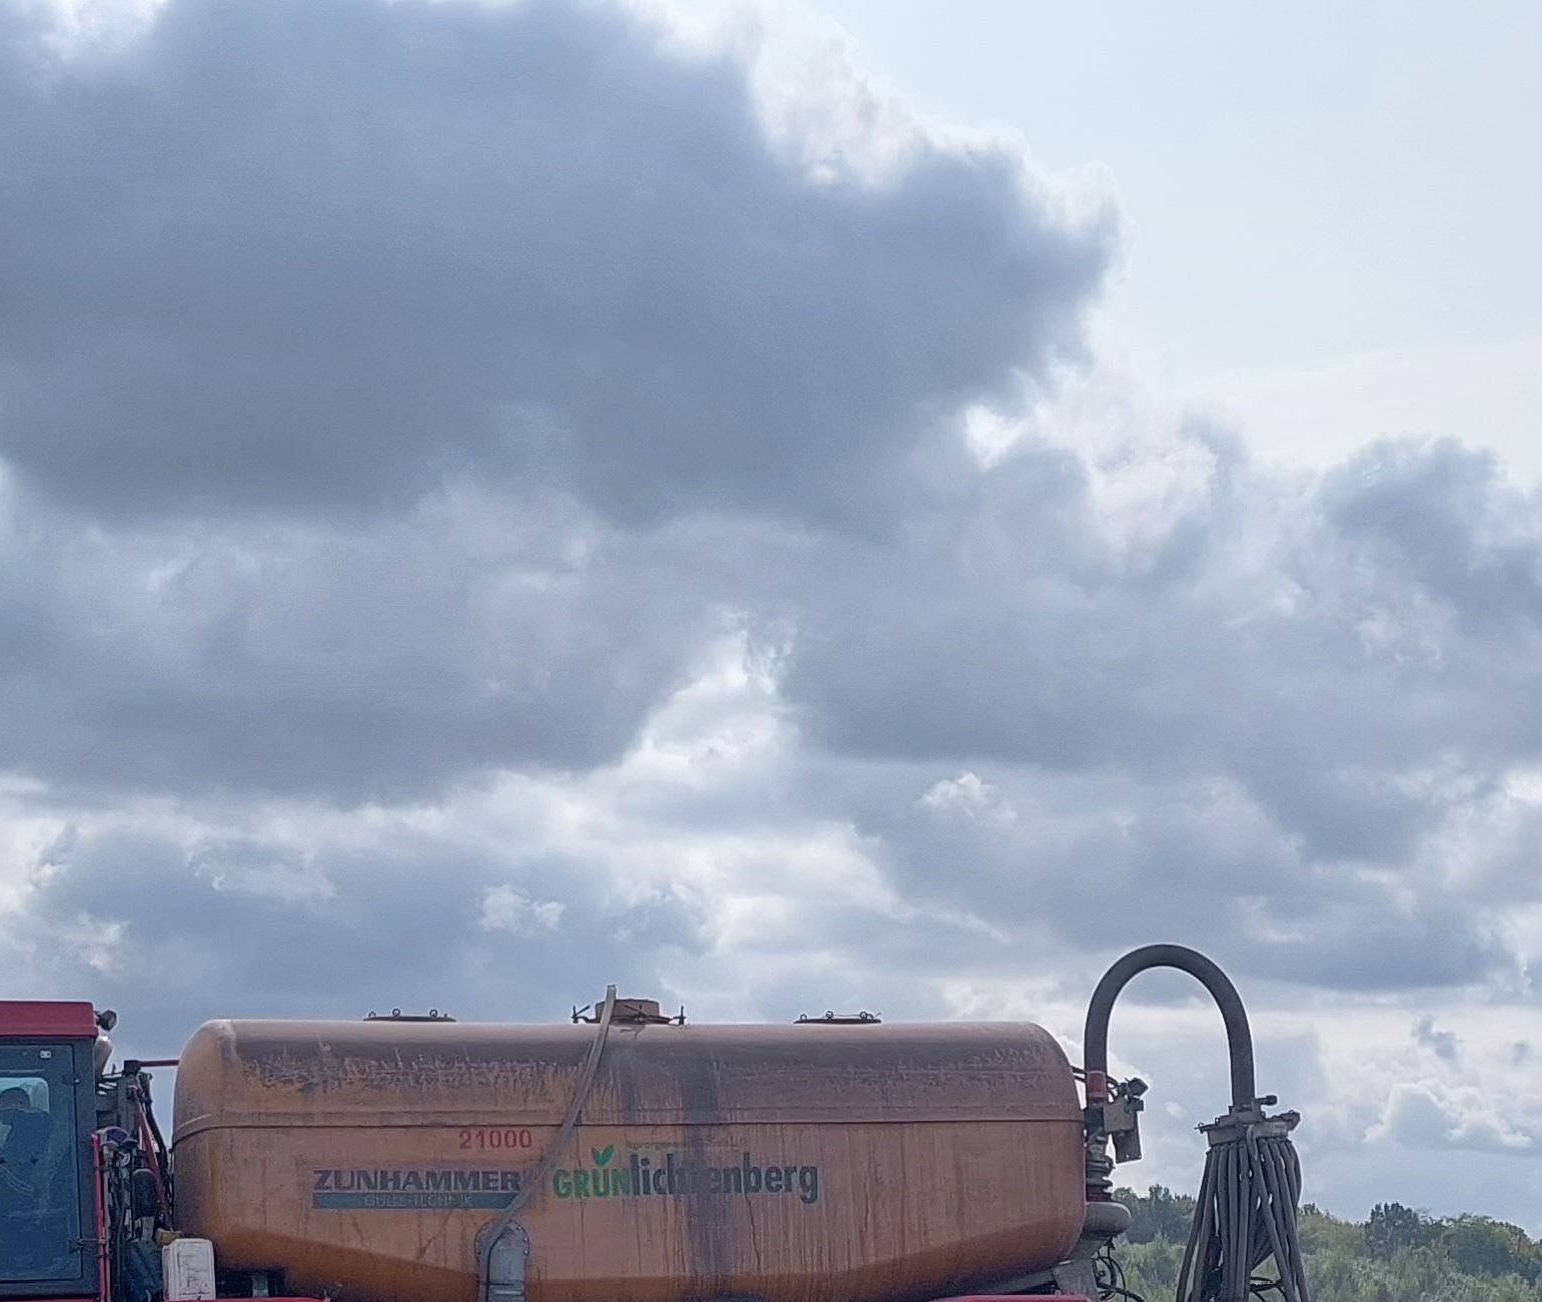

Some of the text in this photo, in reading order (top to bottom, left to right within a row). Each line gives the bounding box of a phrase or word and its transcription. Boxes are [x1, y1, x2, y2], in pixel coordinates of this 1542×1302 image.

[459, 1129, 532, 1149] 21000
[313, 1169, 520, 1191] ZUNHAMMER
[553, 1145, 819, 1204] GRÜNlichenberg
